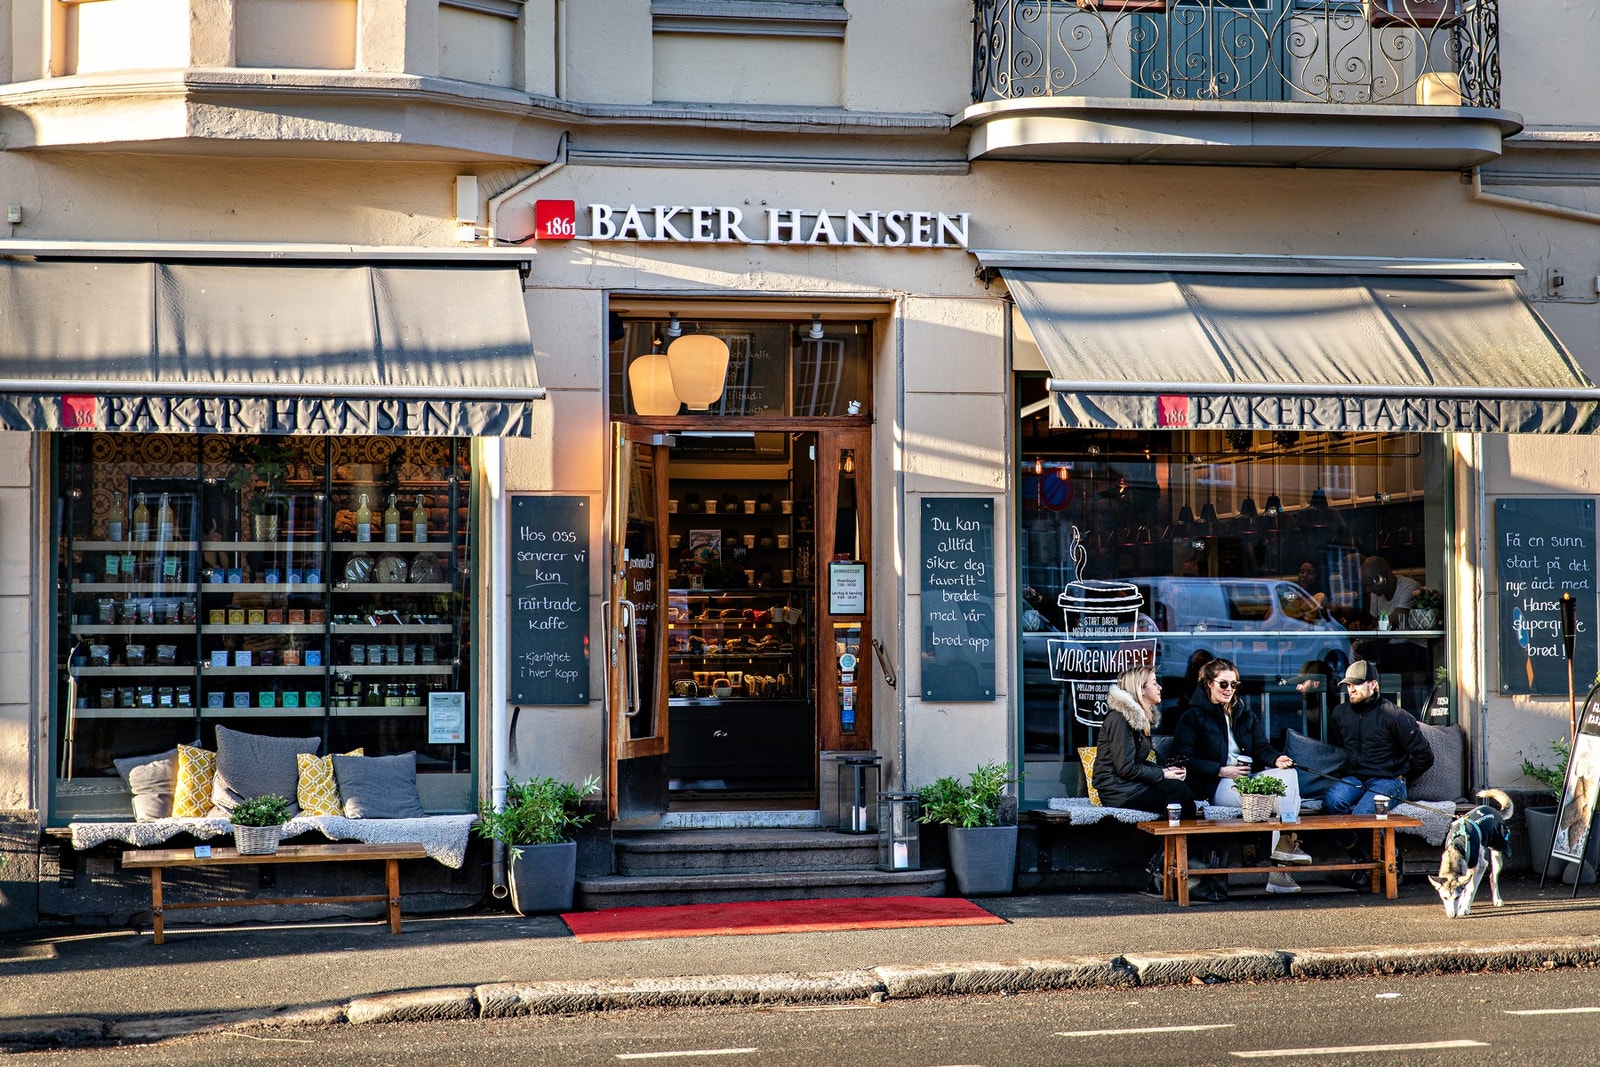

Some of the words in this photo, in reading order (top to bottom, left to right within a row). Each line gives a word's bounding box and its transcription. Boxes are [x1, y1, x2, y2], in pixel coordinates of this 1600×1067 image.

[546, 217, 575, 236] 1861
[589, 204, 753, 243] BAKER
[765, 208, 971, 248] HANSEN
[106, 396, 253, 429] BAKER
[270, 399, 453, 431] HANSEN
[1196, 396, 1326, 427] BAKER
[1339, 398, 1502, 429] HANSEN
[931, 517, 951, 531] Du
[955, 516, 980, 531] kan
[520, 526, 546, 542] Hos
[552, 530, 577, 543] oss
[1506, 532, 1521, 547] Få
[1528, 536, 1544, 548] en
[1551, 536, 1586, 548] sunn
[937, 538, 976, 553] alltid
[517, 551, 568, 562] serverer
[574, 550, 586, 562] vi
[926, 556, 959, 569] sikre
[964, 558, 985, 576] deg
[1506, 555, 1540, 569] start
[1546, 556, 1561, 574] på
[1568, 559, 1590, 572] det
[1506, 580, 1527, 597] nye
[1531, 576, 1555, 590] året
[1561, 578, 1589, 590] med
[942, 589, 980, 602] brødet
[518, 597, 581, 612] Fairtrade
[930, 609, 957, 622] med
[963, 609, 986, 622] vår
[1084, 617, 1101, 626] START
[1055, 647, 1149, 674] MORGENKAFFE
[529, 668, 551, 678] hver
[1077, 684, 1095, 692] MELLOM
